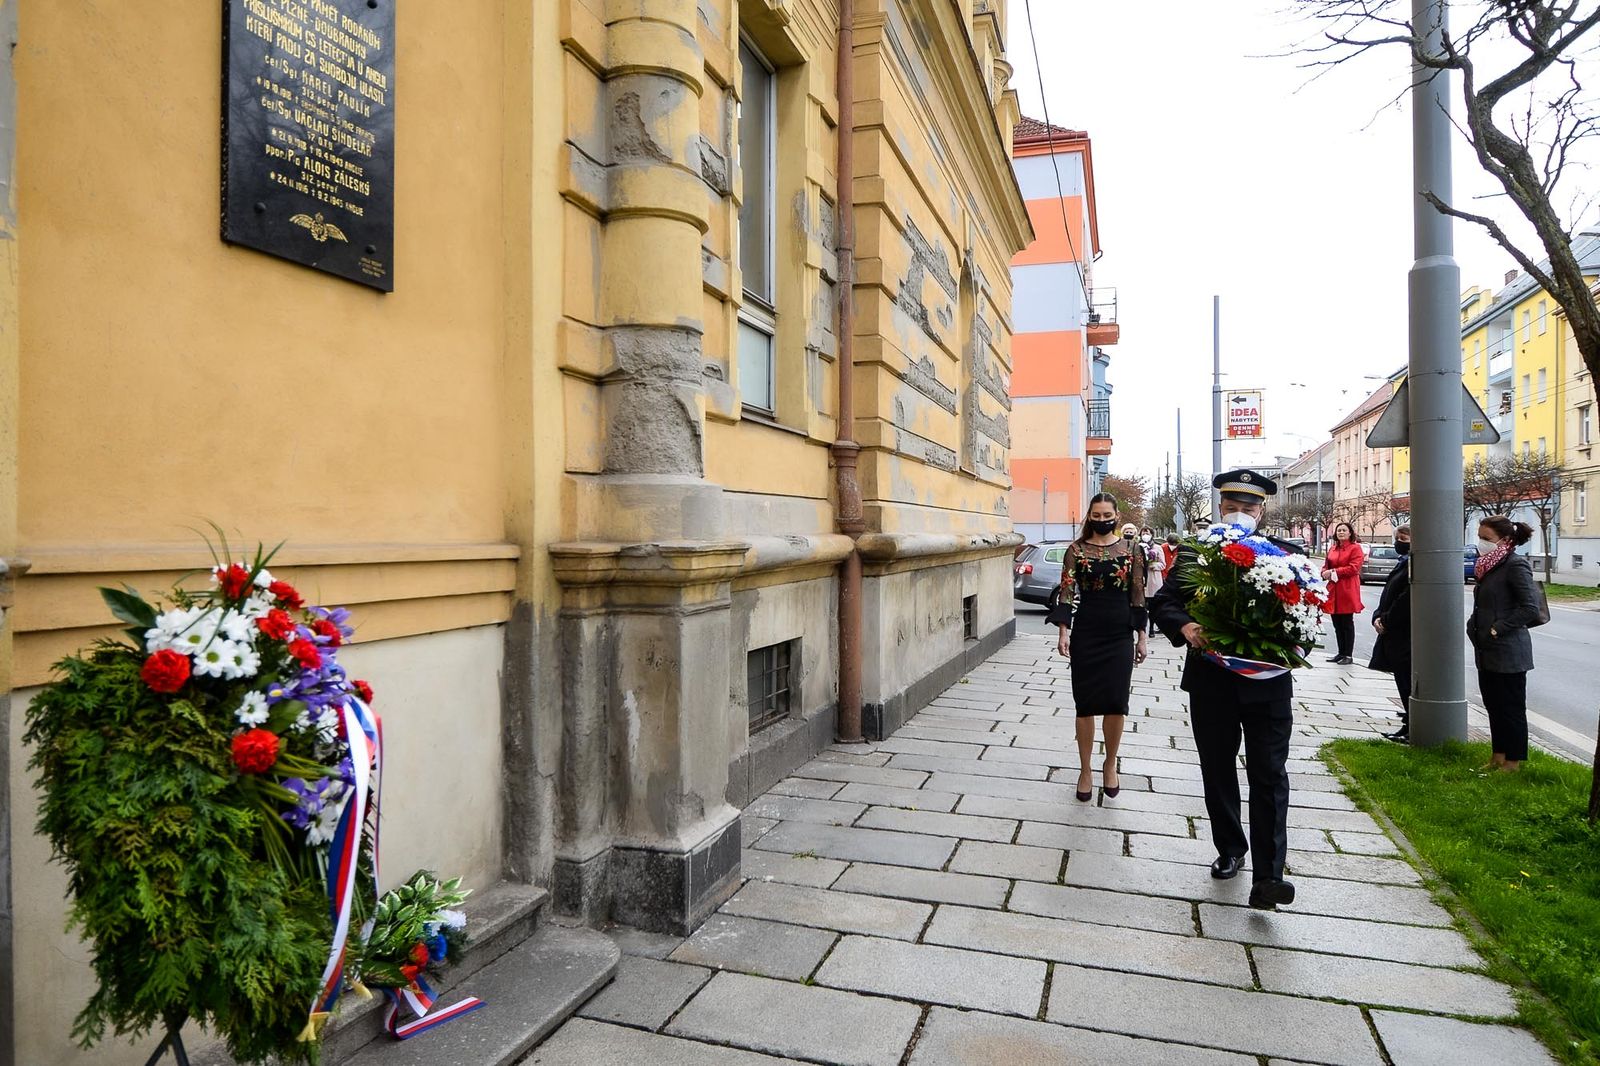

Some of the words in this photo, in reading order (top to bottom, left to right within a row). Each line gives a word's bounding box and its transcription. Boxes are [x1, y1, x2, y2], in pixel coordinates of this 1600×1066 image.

[304, 48, 316, 68] ZA
[302, 70, 332, 98] KAREL
[304, 156, 330, 179] ALOIS
[334, 170, 370, 197] ZÁLESKÝ
